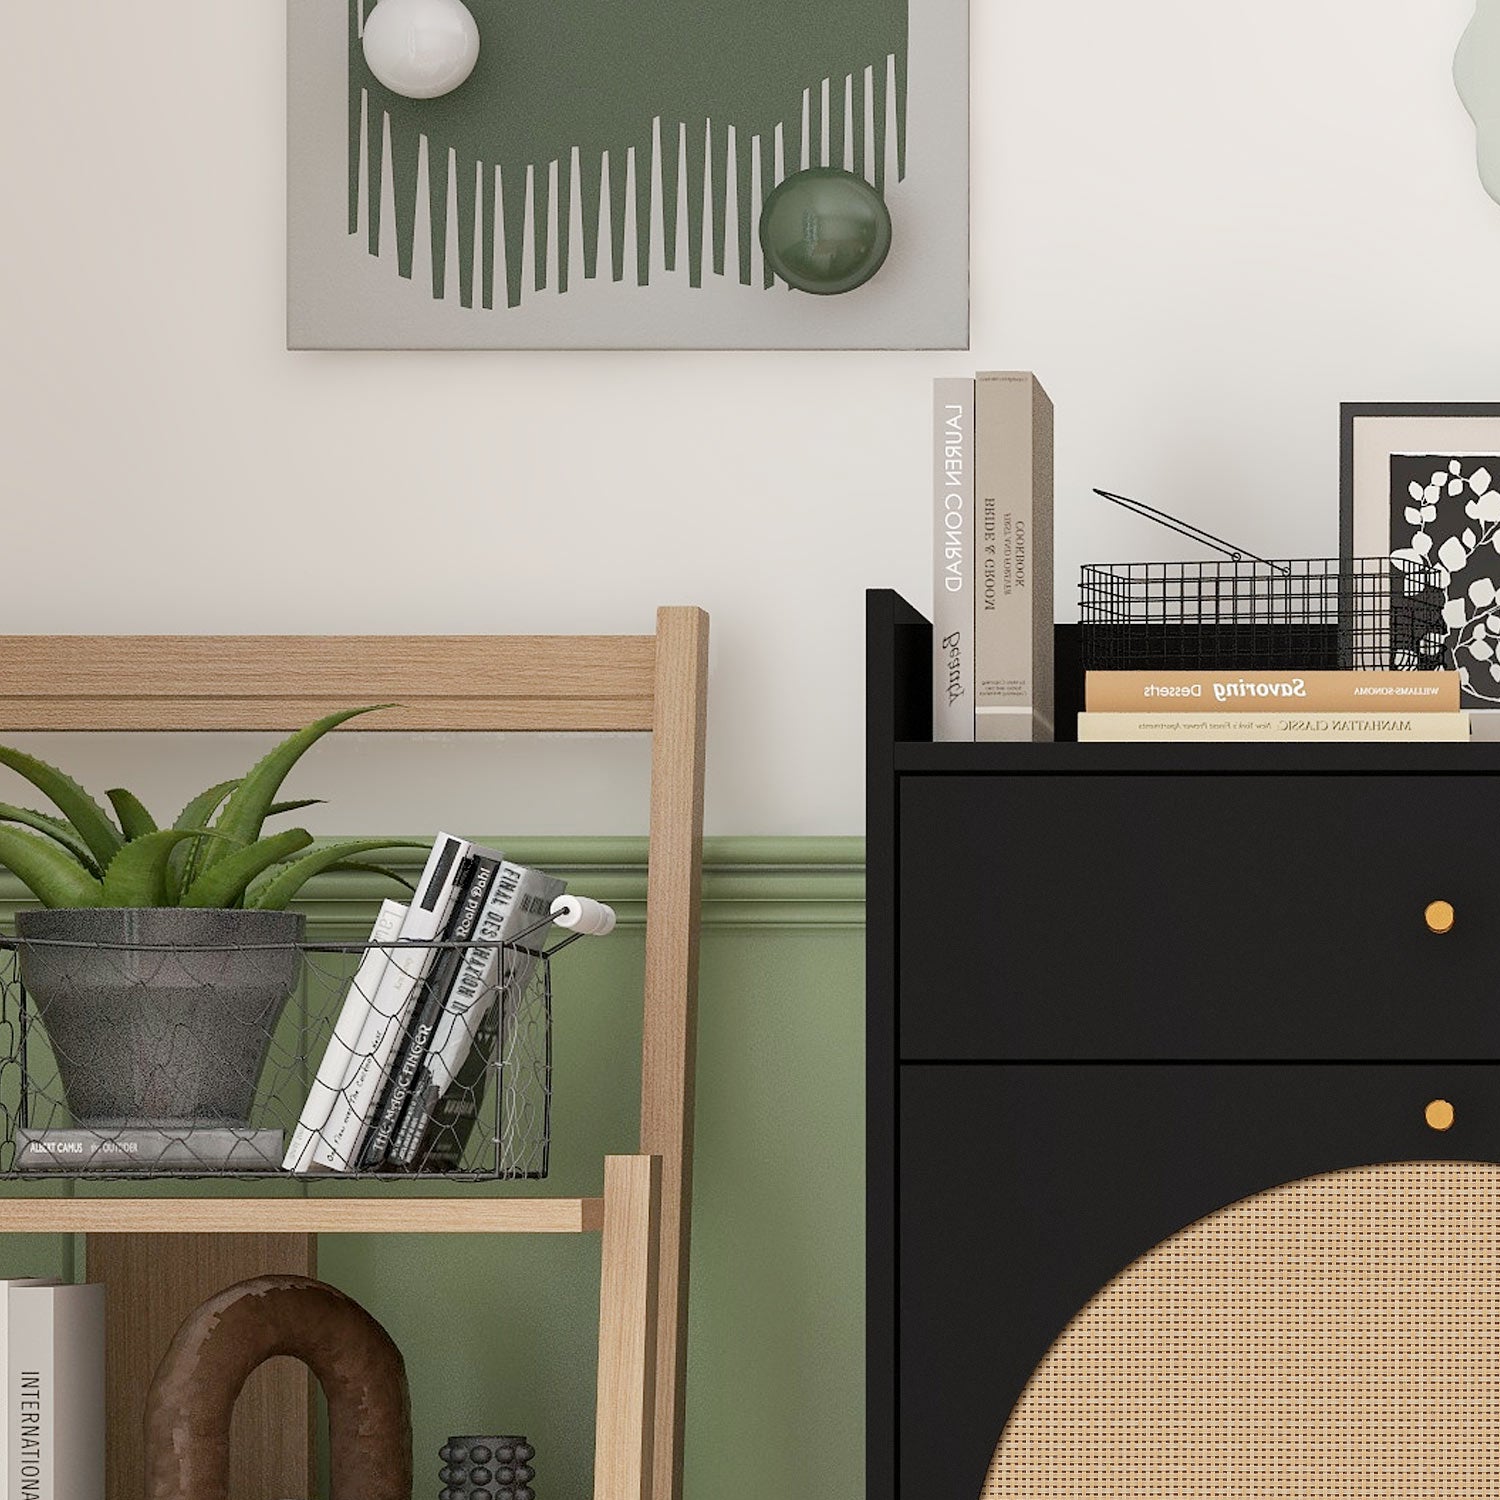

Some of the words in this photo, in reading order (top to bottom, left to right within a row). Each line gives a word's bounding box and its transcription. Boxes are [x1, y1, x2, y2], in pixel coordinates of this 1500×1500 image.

[455, 898, 479, 938] Roald
[470, 867, 491, 898] Dahl
[490, 867, 521, 906] FINAL
[456, 911, 505, 998] DESNATION
[402, 1023, 433, 1076] FINGER
[56, 1142, 83, 1154] CAMUS
